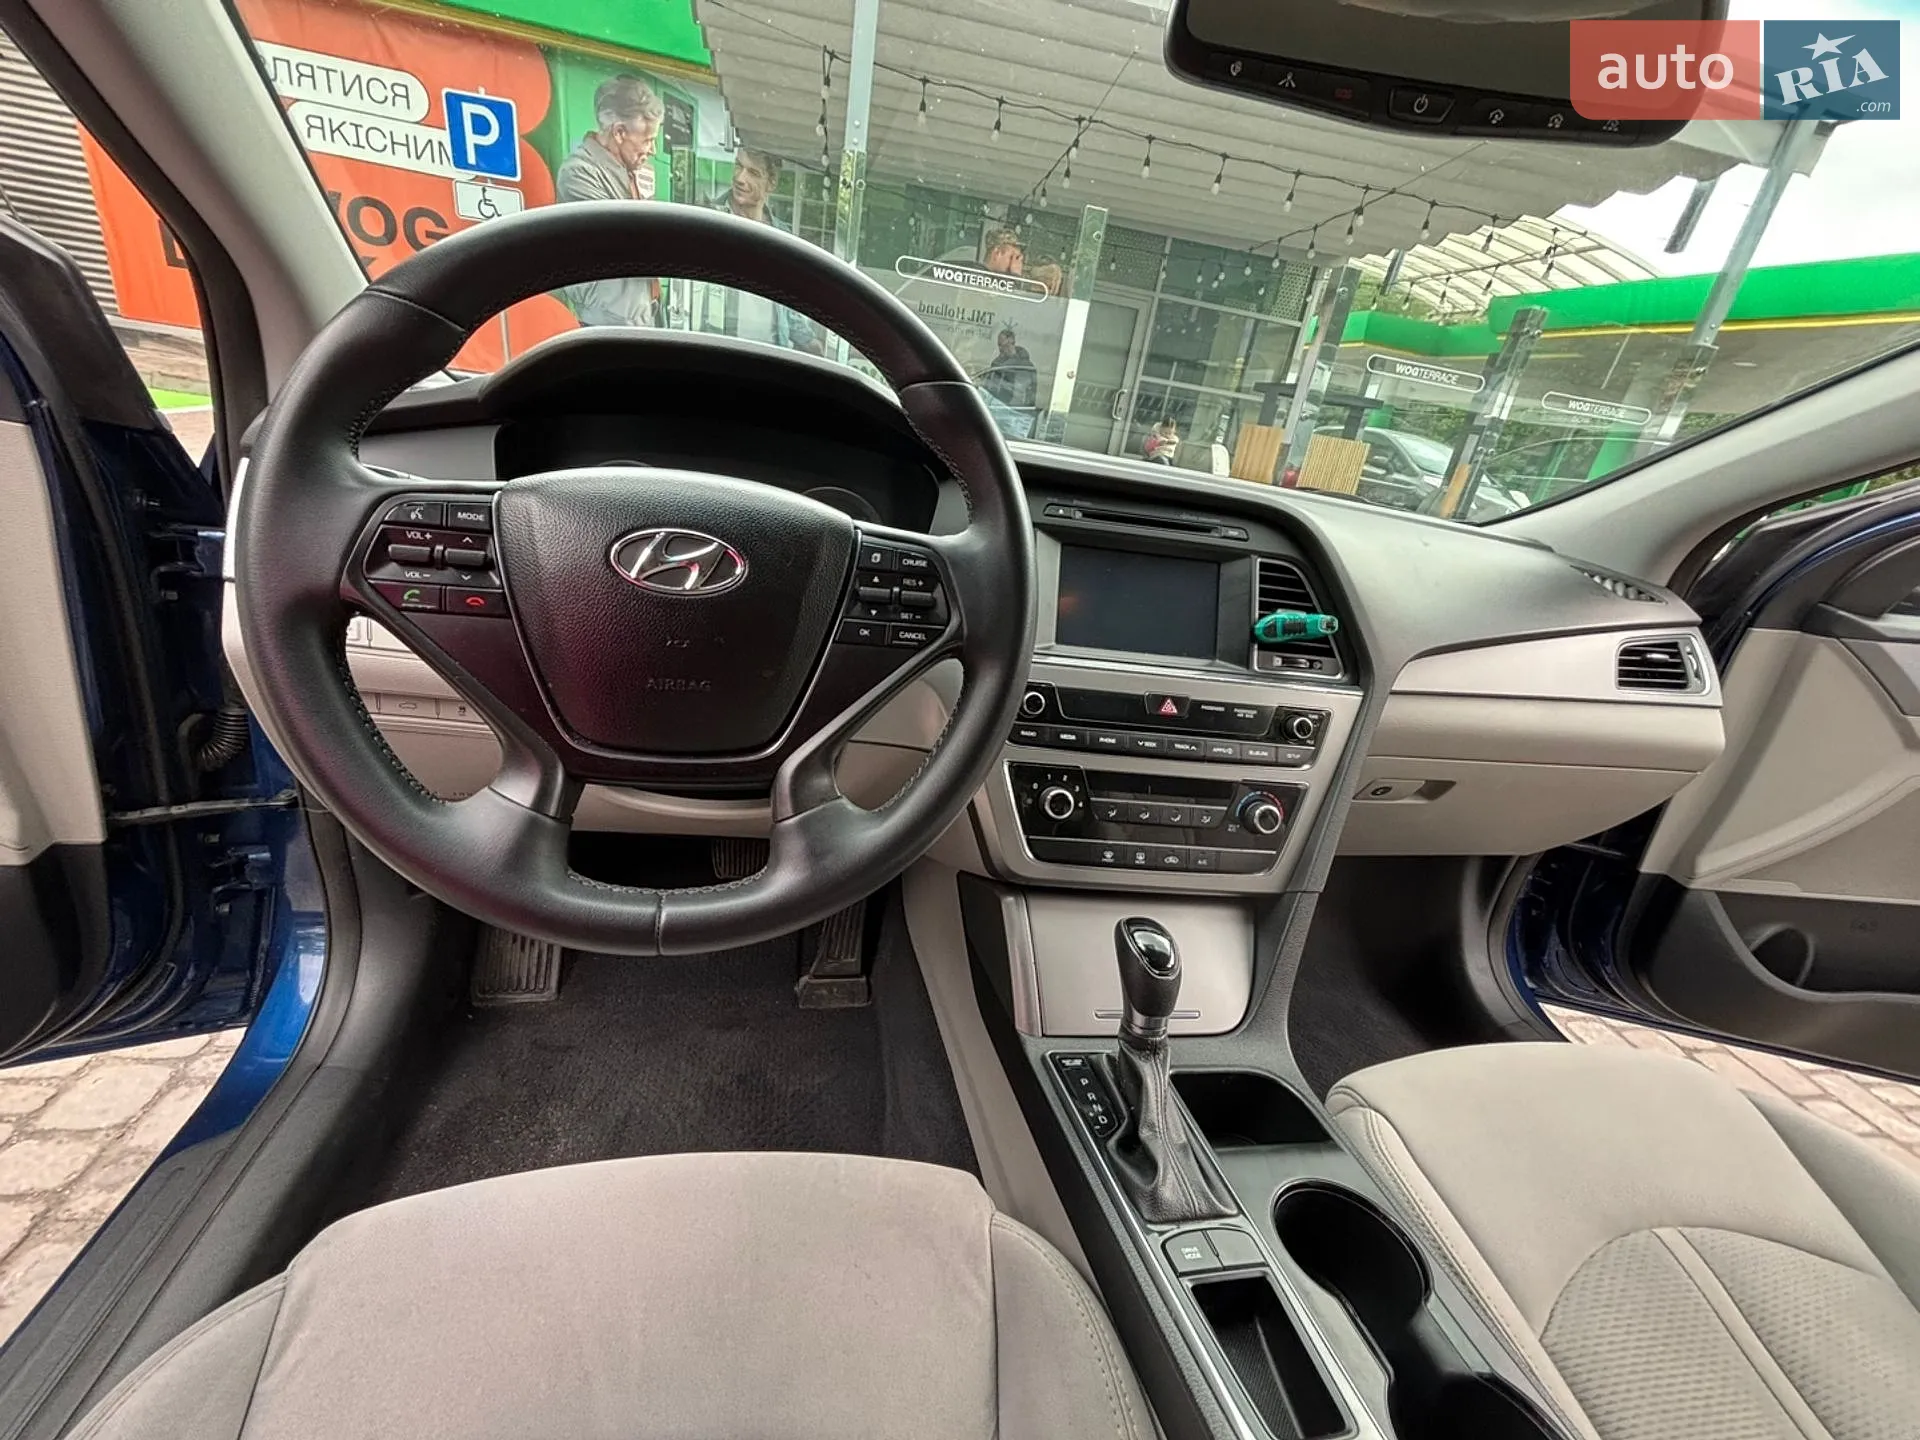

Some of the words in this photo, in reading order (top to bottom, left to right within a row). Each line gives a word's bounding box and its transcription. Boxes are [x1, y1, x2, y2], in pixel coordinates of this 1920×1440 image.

[460, 101, 500, 166] P
[932, 266, 1015, 293] WOGTERRACE
[1395, 363, 1460, 387] WOGTERRACE
[457, 511, 485, 521] MODE
[902, 558, 928, 568] CRUISE
[898, 631, 927, 641] CANCEL
